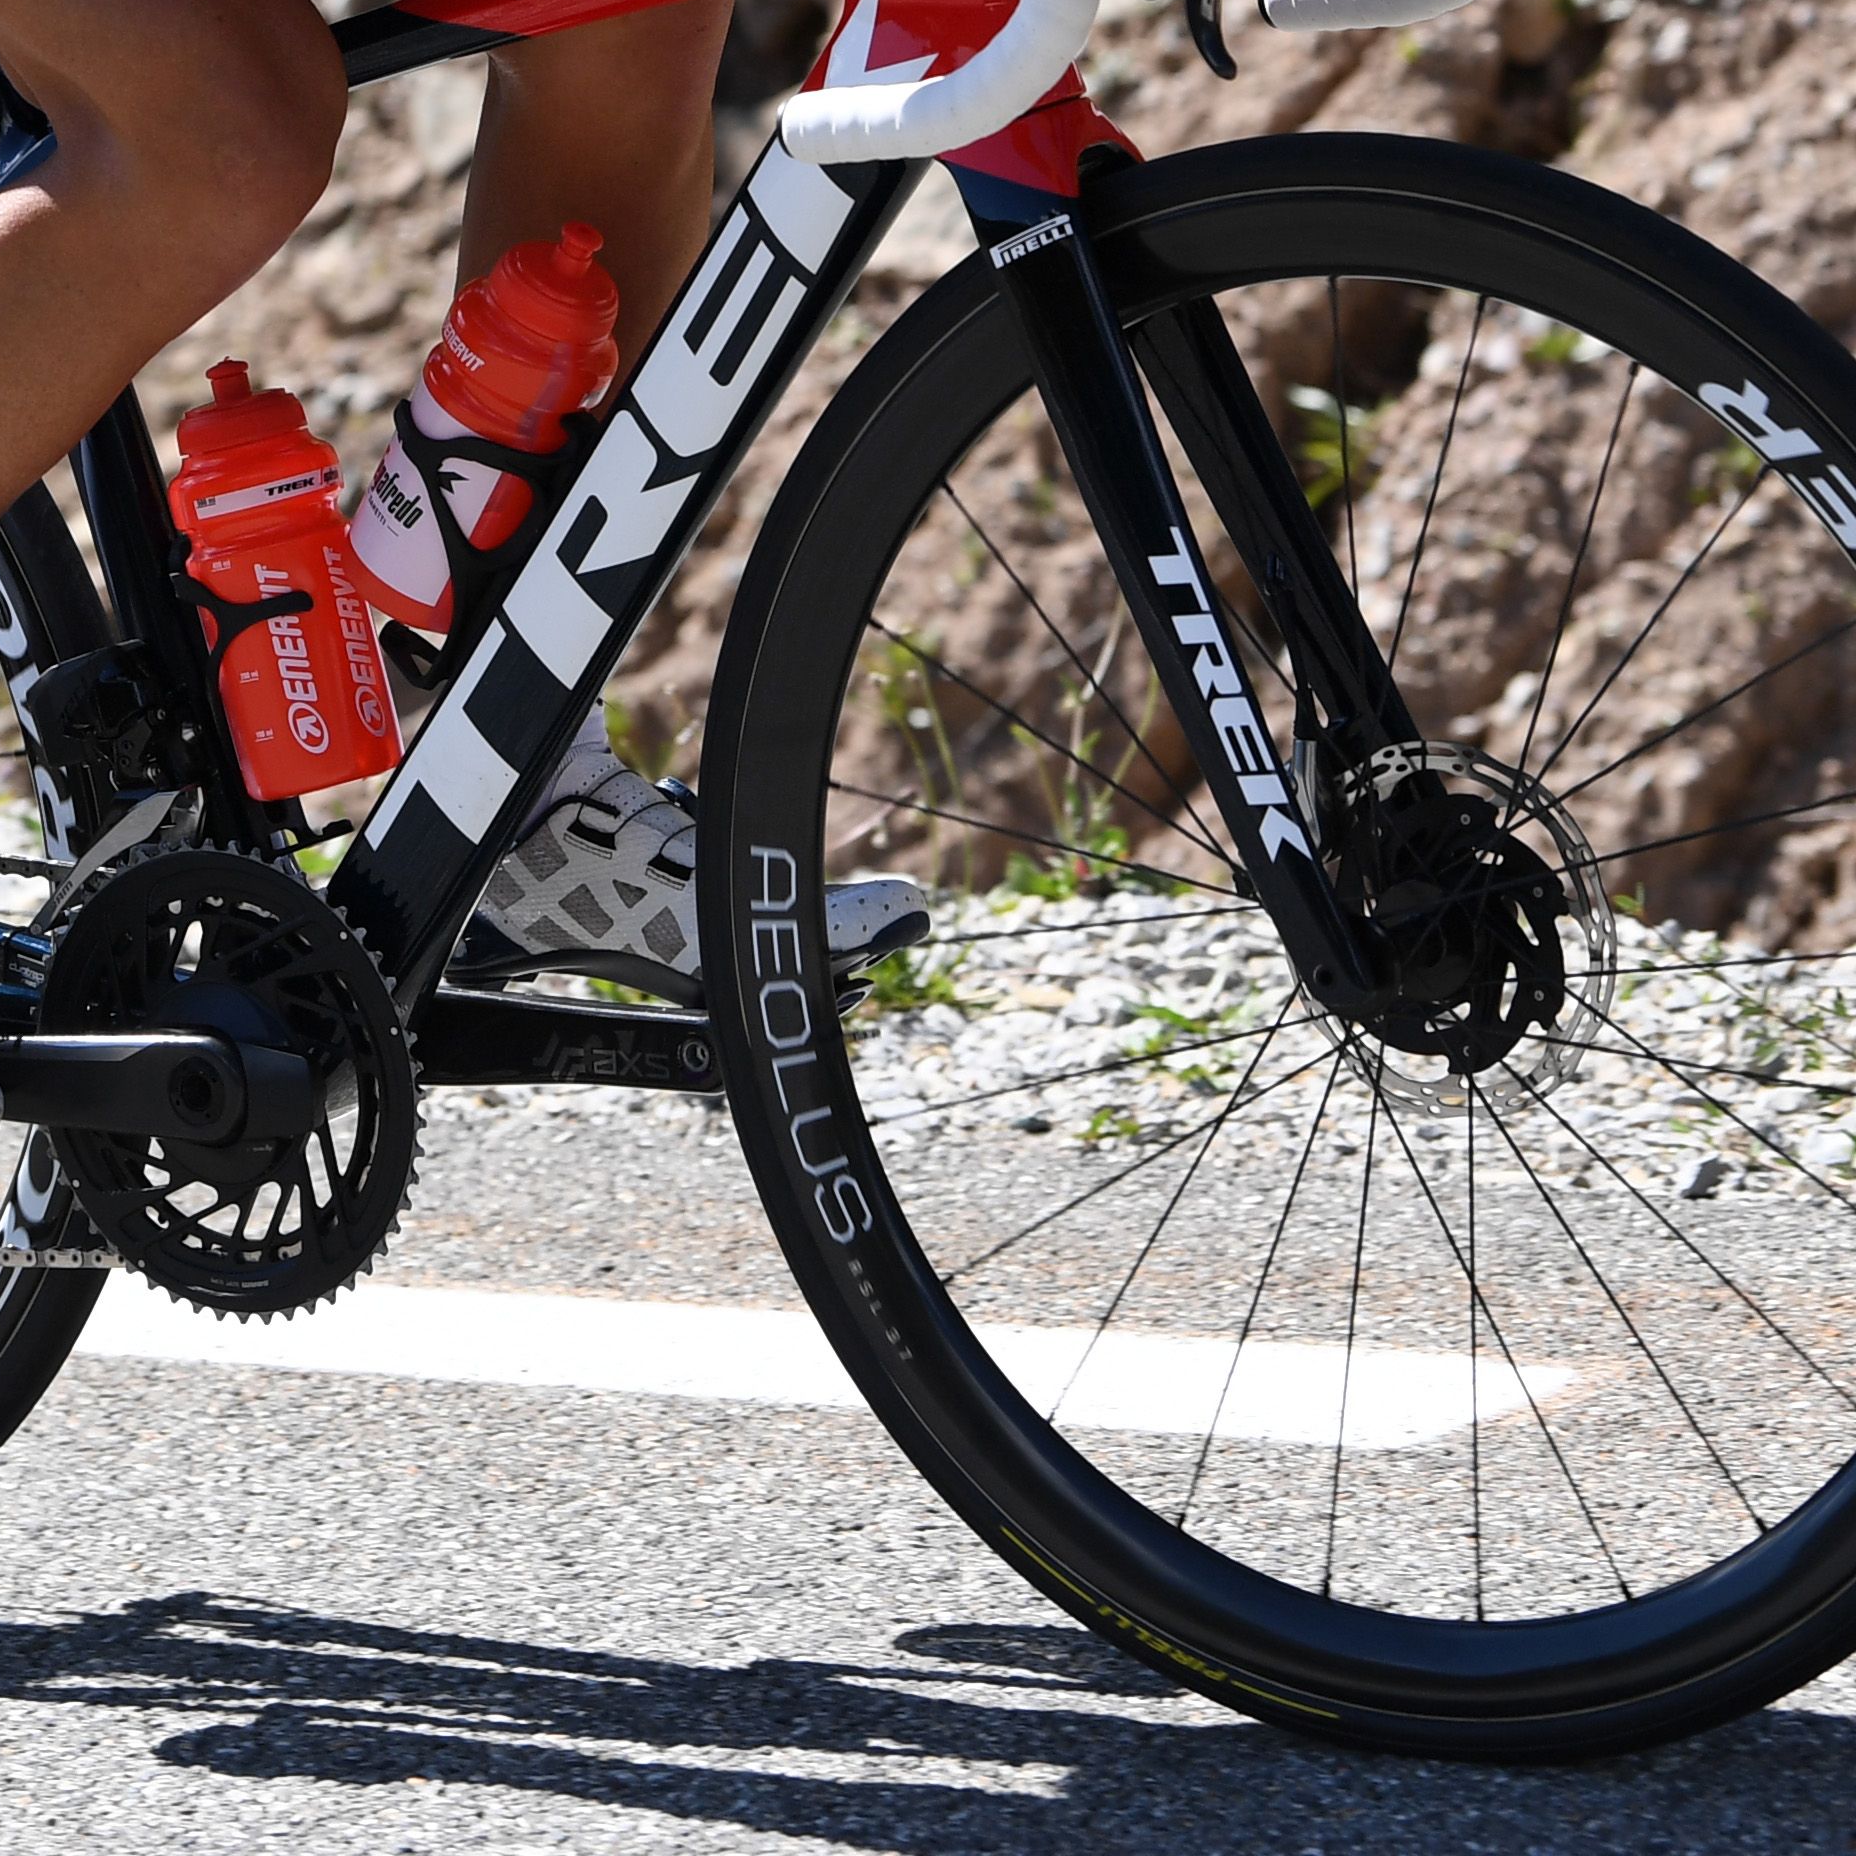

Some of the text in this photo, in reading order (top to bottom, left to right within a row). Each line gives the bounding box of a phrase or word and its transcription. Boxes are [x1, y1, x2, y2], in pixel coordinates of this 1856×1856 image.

[989, 213, 1075, 270] PIRELLI
[264, 477, 315, 497] TREK
[323, 545, 377, 686] ENERVIT
[1147, 526, 1312, 864] TREK
[749, 845, 874, 1244] AEOLUS
[1097, 1603, 1230, 1682] PIRELLI
